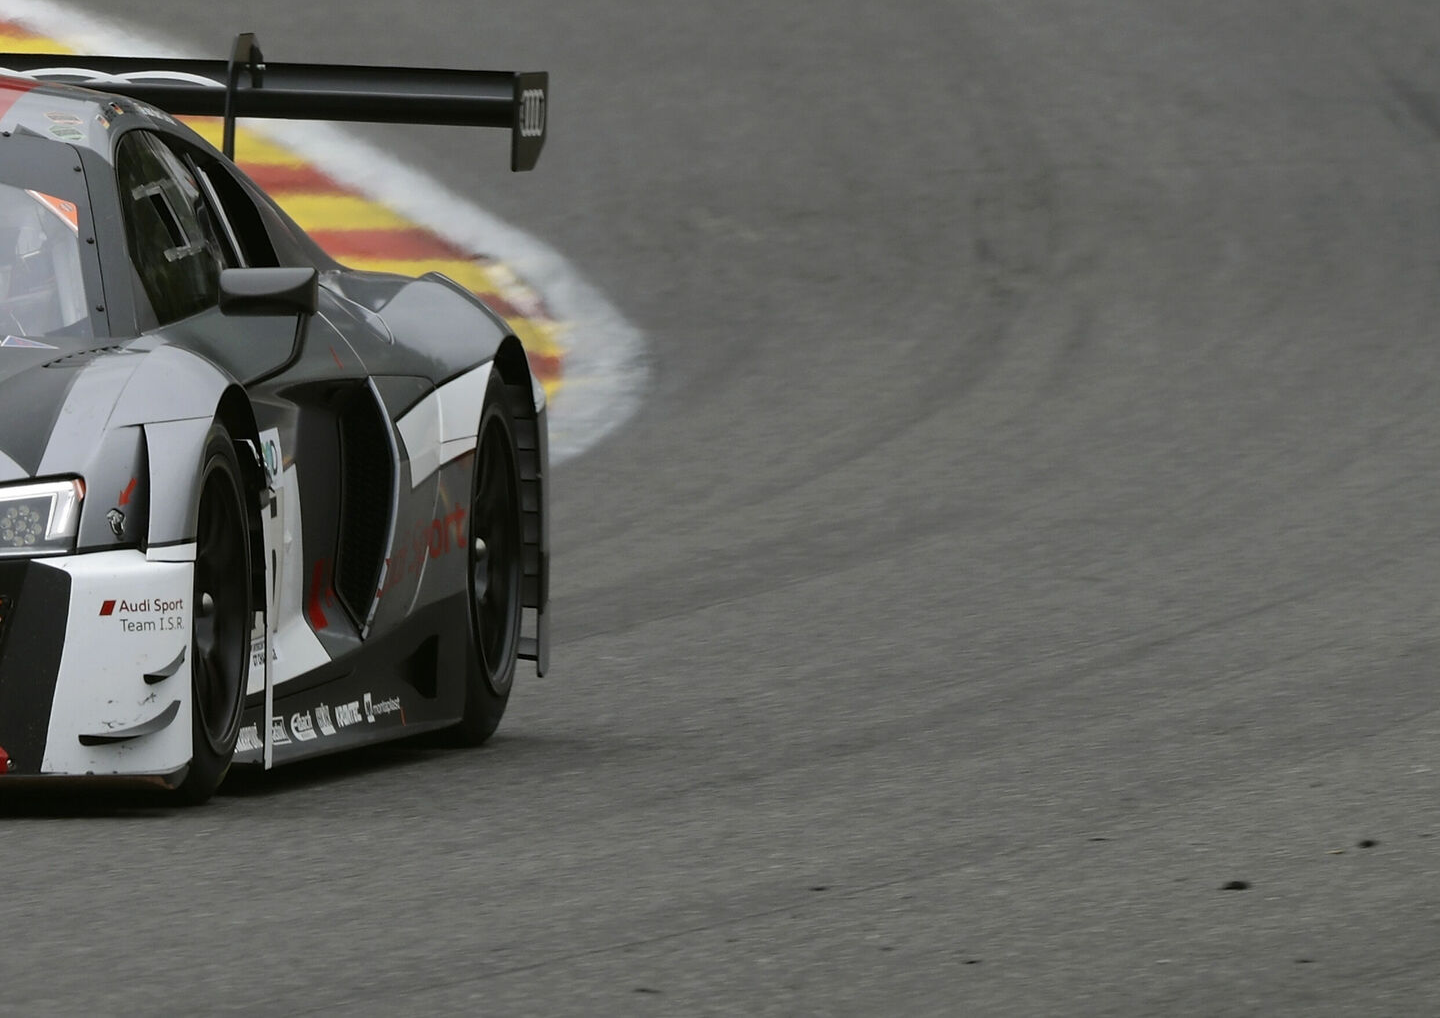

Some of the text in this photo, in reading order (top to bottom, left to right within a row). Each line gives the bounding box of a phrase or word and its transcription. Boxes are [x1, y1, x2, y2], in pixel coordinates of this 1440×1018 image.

[119, 598, 184, 614] Audi Sport
[119, 618, 156, 632] Team
